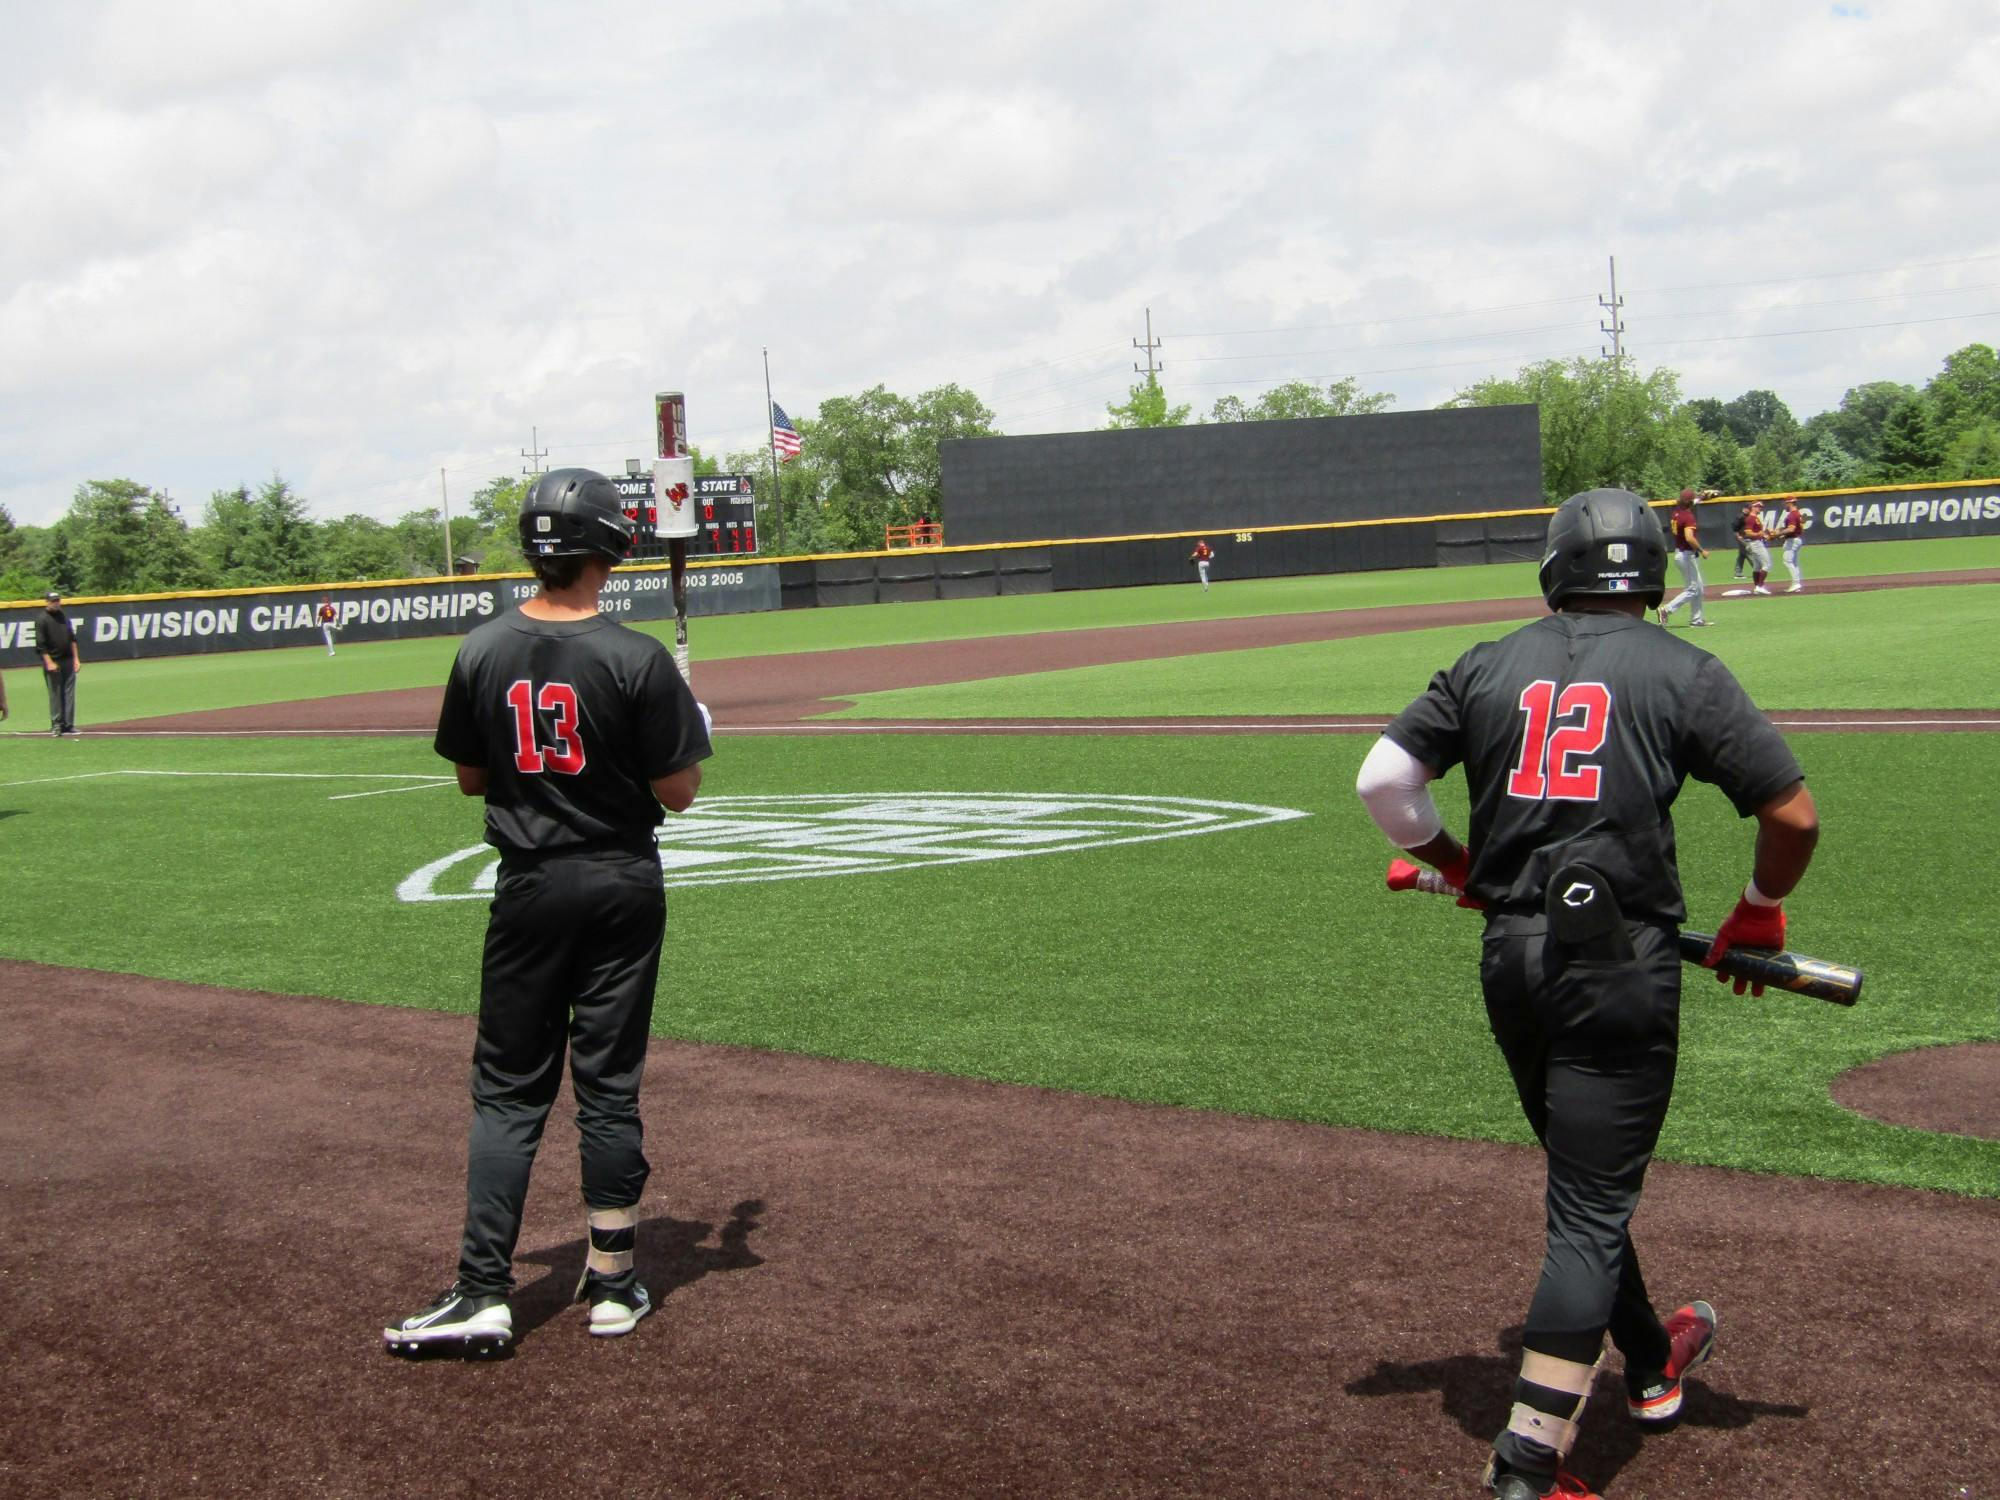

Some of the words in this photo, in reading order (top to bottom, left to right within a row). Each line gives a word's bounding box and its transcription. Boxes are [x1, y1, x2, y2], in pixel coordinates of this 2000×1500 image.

[701, 480, 737, 492] STATE
[702, 498, 714, 506] OUT
[704, 505, 713, 520] 0
[1823, 496, 2000, 528] CHAMPIONS
[598, 580, 630, 594] 000
[634, 577, 668, 591] 2001
[711, 572, 744, 586] 2005
[597, 598, 631, 613] 2016
[94, 608, 239, 642] DIVISION
[507, 680, 586, 775] 13
[1507, 679, 1611, 801] 12
